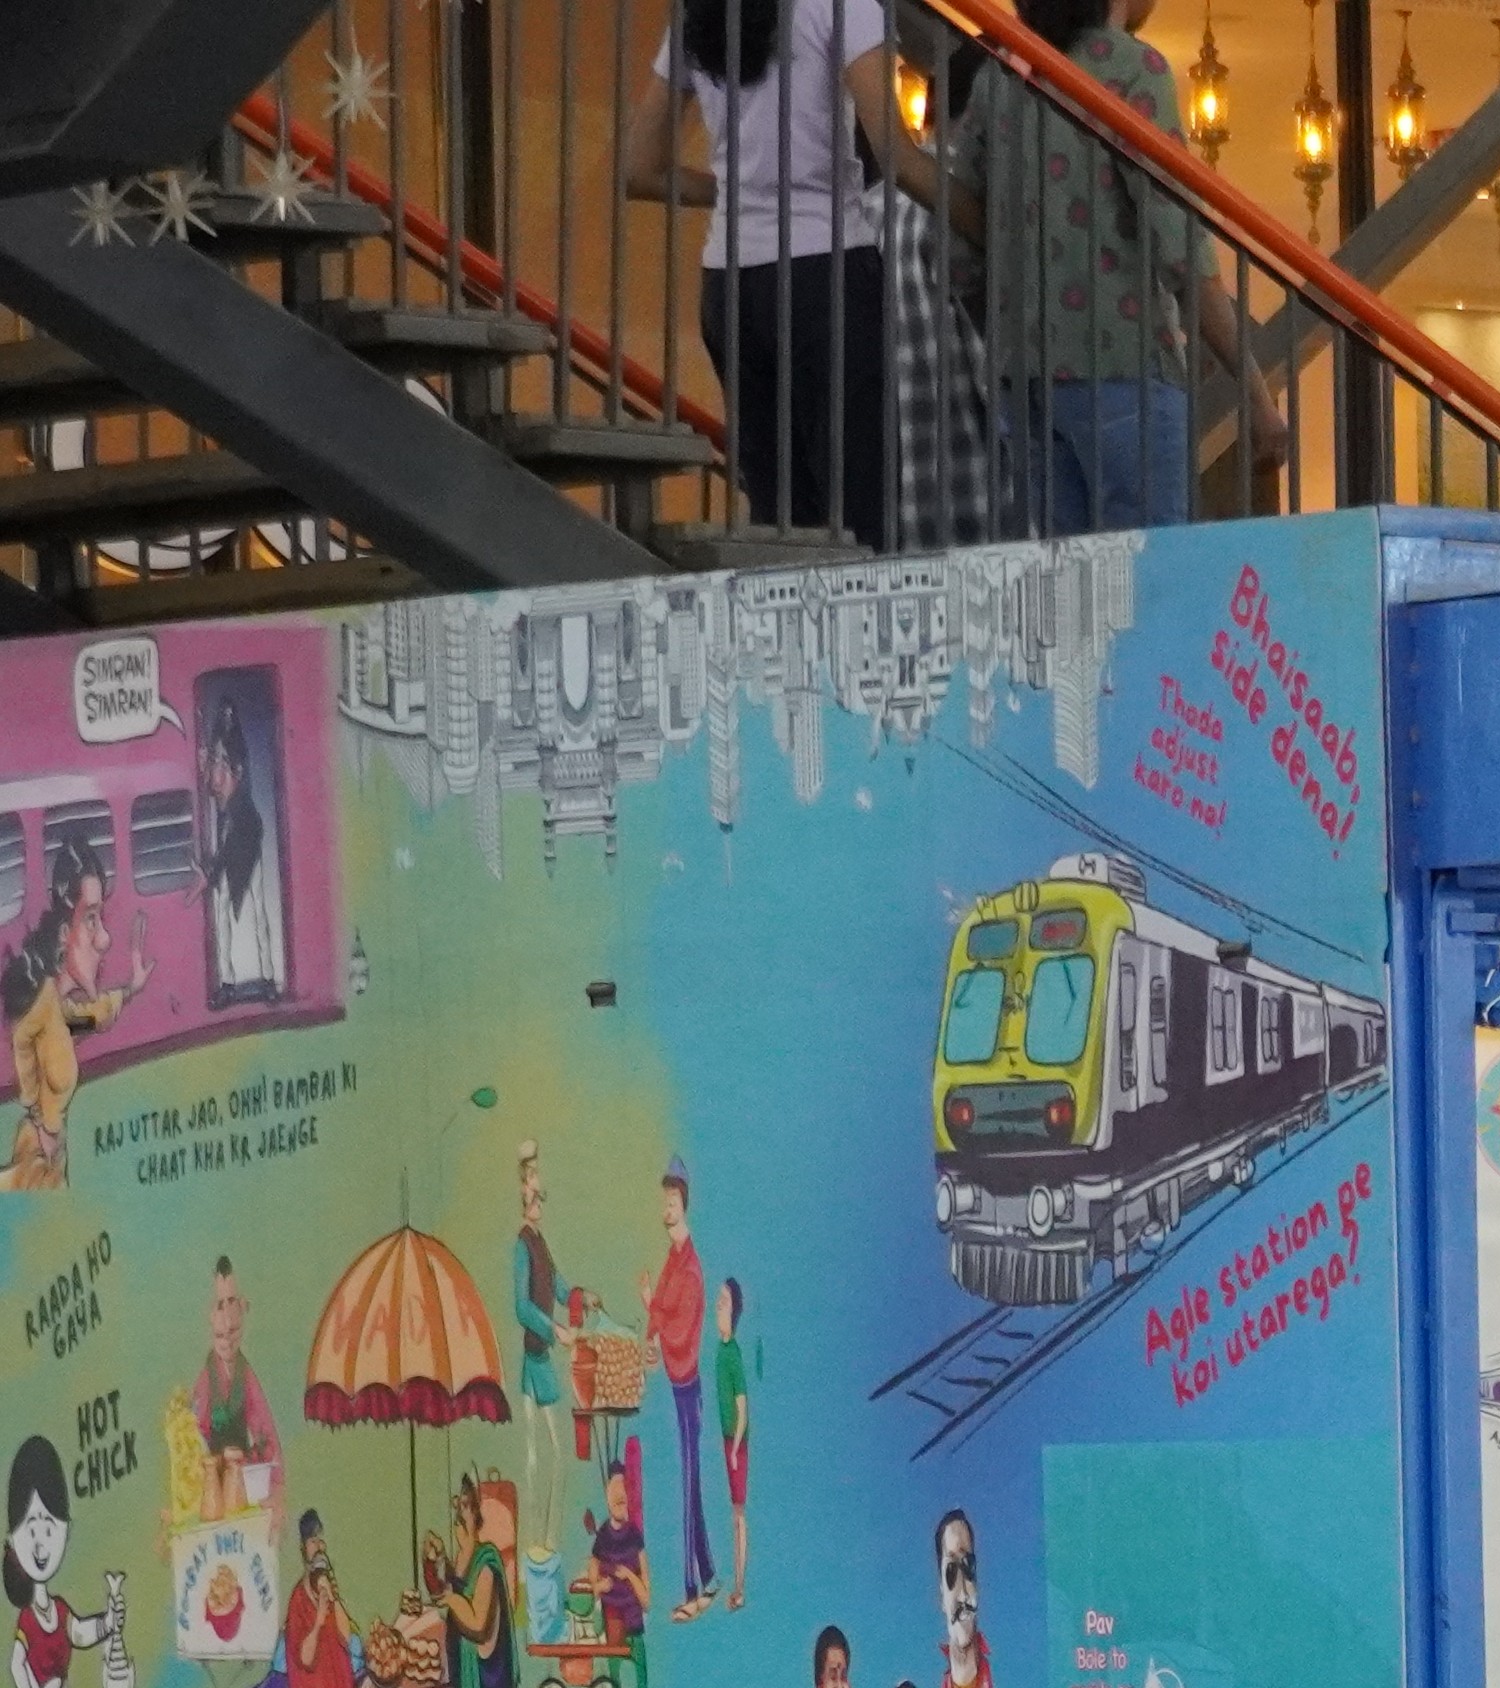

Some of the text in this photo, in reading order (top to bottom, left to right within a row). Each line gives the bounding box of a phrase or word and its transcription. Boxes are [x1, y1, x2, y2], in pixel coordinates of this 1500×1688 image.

[1210, 629, 1269, 726] Side
[1133, 750, 1185, 811] karo
[1150, 726, 1220, 786] adjust
[93, 1065, 337, 1158] RAJ UTTAR BAMBAI
[136, 1141, 226, 1187] CHAAT KHA
[24, 1229, 113, 1350] RAADA HO
[1143, 1201, 1330, 1367] Agle station
[52, 1290, 103, 1359] GAYA
[1170, 1338, 1220, 1409] koi
[76, 1388, 122, 1449] HOT
[73, 1430, 139, 1499] CHICK
[1085, 1609, 1115, 1637] Pav
[1075, 1647, 1128, 1670] Bole to
